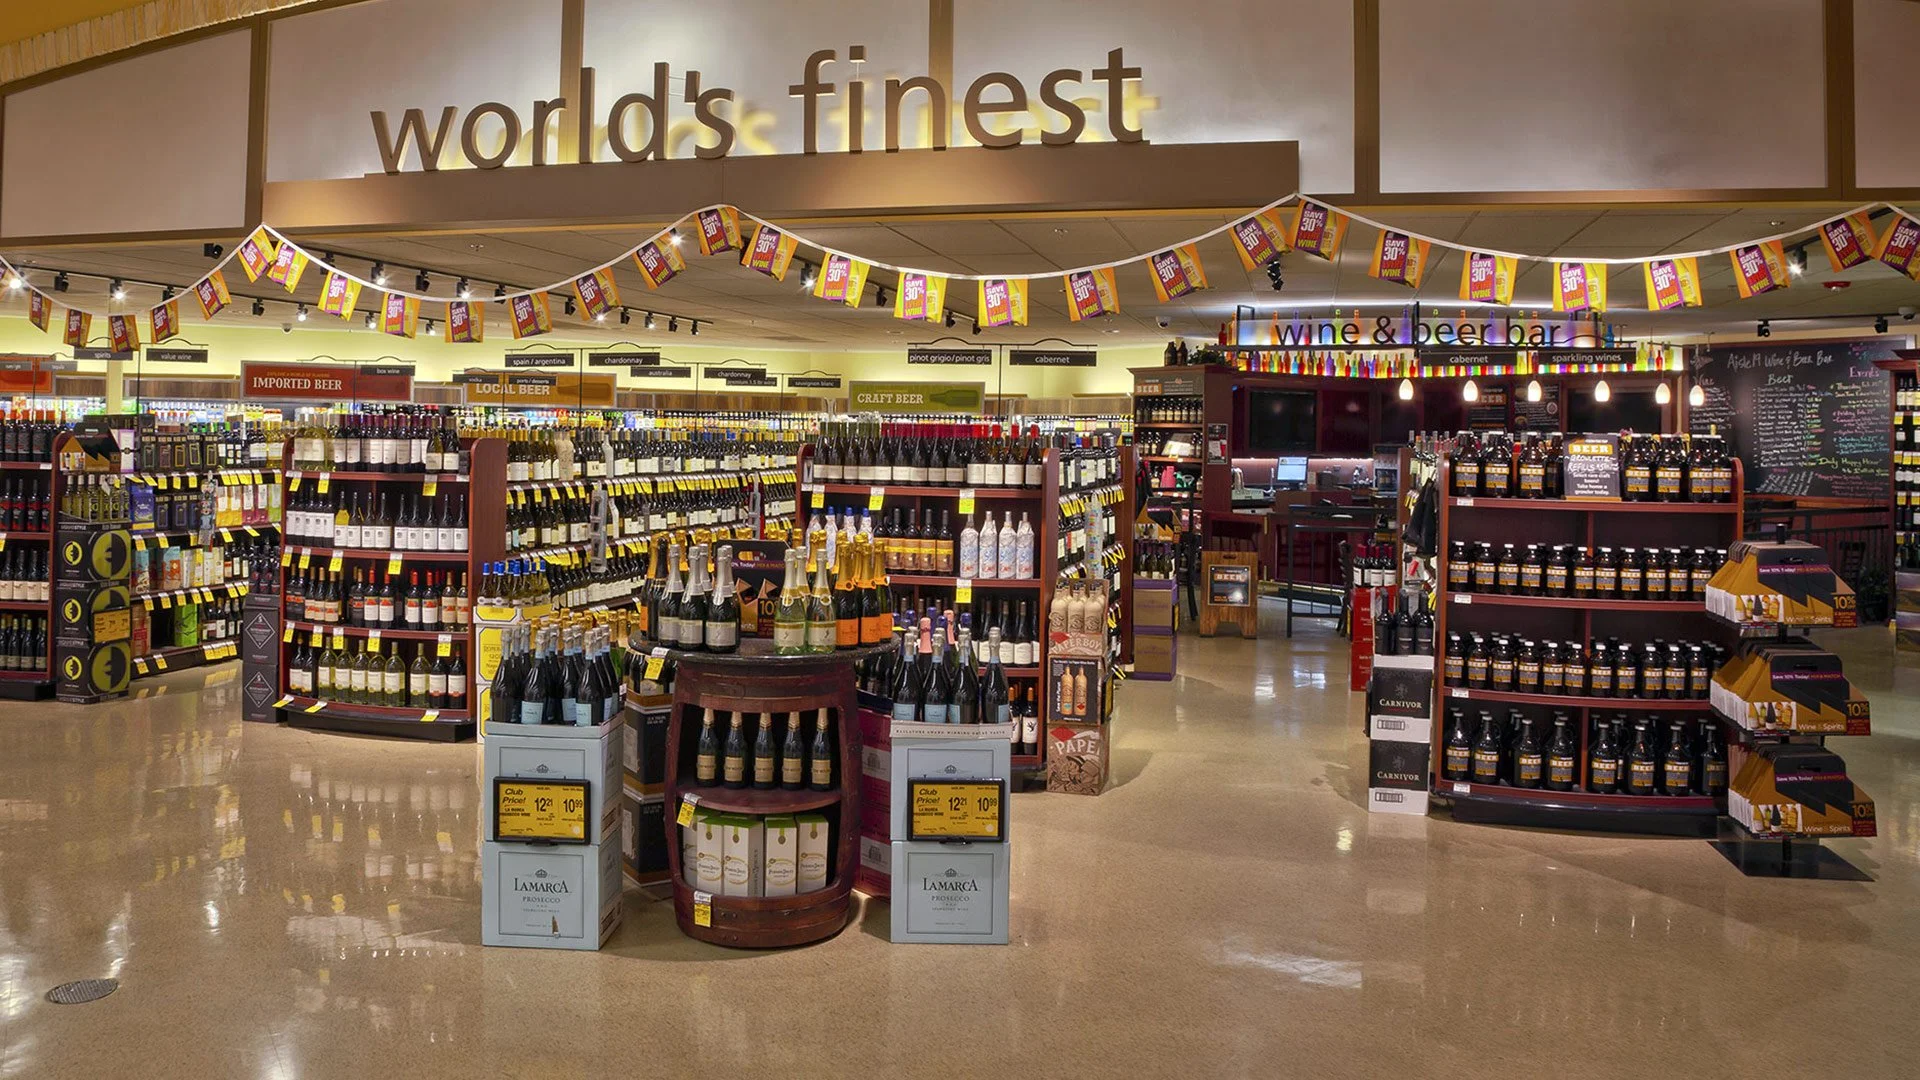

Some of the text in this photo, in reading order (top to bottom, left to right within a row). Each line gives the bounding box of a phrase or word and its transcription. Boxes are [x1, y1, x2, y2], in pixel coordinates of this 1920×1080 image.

[369, 45, 1146, 173] world's finest
[1303, 210, 1323, 219] SAVE
[1300, 217, 1323, 232] 30%
[1239, 223, 1257, 240] SAVE
[1828, 223, 1848, 240] SAVE
[1898, 225, 1919, 237] SAVE
[759, 233, 777, 243] SAVE
[1243, 229, 1262, 251] 30%
[1297, 238, 1317, 248] WINE
[1385, 239, 1405, 247] SAVE
[1831, 230, 1852, 252] 30%
[1891, 233, 1917, 248] 30%
[756, 240, 776, 253] 30%
[1254, 247, 1273, 264] WINE
[1383, 246, 1406, 261] 30%
[1739, 251, 1760, 264] SAVE
[1842, 251, 1860, 267] WINE
[1884, 253, 1906, 265] WINE
[752, 259, 769, 269] WINE
[829, 262, 848, 270] SAVE
[1156, 257, 1175, 273] SAVE
[1743, 258, 1764, 278] 30%
[827, 268, 847, 282] 30%
[1159, 263, 1179, 283] 30%
[1381, 268, 1401, 277] WINE
[1471, 267, 1493, 282] 30%
[1562, 268, 1582, 279] SAVE
[1651, 265, 1672, 277] SAVE
[905, 280, 924, 288] SAVE
[1072, 276, 1091, 289] SAVE
[1168, 280, 1187, 297] WINE
[1563, 276, 1584, 293] 30%
[1654, 274, 1676, 291] 30%
[1750, 278, 1770, 293] WINE
[825, 289, 843, 297] WINE
[905, 287, 924, 301] 30%
[985, 285, 1004, 296] SAVE
[1074, 283, 1094, 302] 30%
[1471, 289, 1491, 299] WINE
[988, 292, 1007, 308] 30%
[1566, 298, 1585, 309] WINE
[1660, 293, 1680, 307] WINE
[905, 307, 923, 315] WINE
[1080, 303, 1099, 317] WINE
[990, 312, 1009, 323] WINE
[1275, 314, 1561, 346] wine & beer bar
[94, 351, 112, 359] spirits
[161, 352, 177, 360] value
[604, 357, 643, 365] chardonnay
[909, 353, 929, 362] pinot
[976, 355, 990, 364] gris
[1035, 354, 1070, 364] cabernet
[1449, 354, 1489, 364] cabernet
[1551, 353, 1622, 365] sparkling wines
[513, 358, 530, 366] spain
[534, 357, 566, 366] argentina
[717, 371, 752, 379] chardonnay
[1767, 373, 1794, 386] Beer
[253, 377, 342, 391] IMPORTED BEER
[475, 383, 550, 396] LOCAL BEER
[1136, 385, 1159, 393] BEER
[857, 393, 924, 404] CRAFT BEER
[1572, 444, 1609, 453] BEER
[1833, 595, 1856, 610] 10%
[1051, 637, 1101, 655] PAPERBOY
[1847, 703, 1869, 717] 10%
[1823, 722, 1845, 732] Spirits
[504, 788, 524, 796] Club
[919, 788, 938, 796] Club
[1852, 804, 1873, 818] 10%
[1829, 824, 1851, 833] Spirits
[522, 896, 561, 904] PROSECCO
